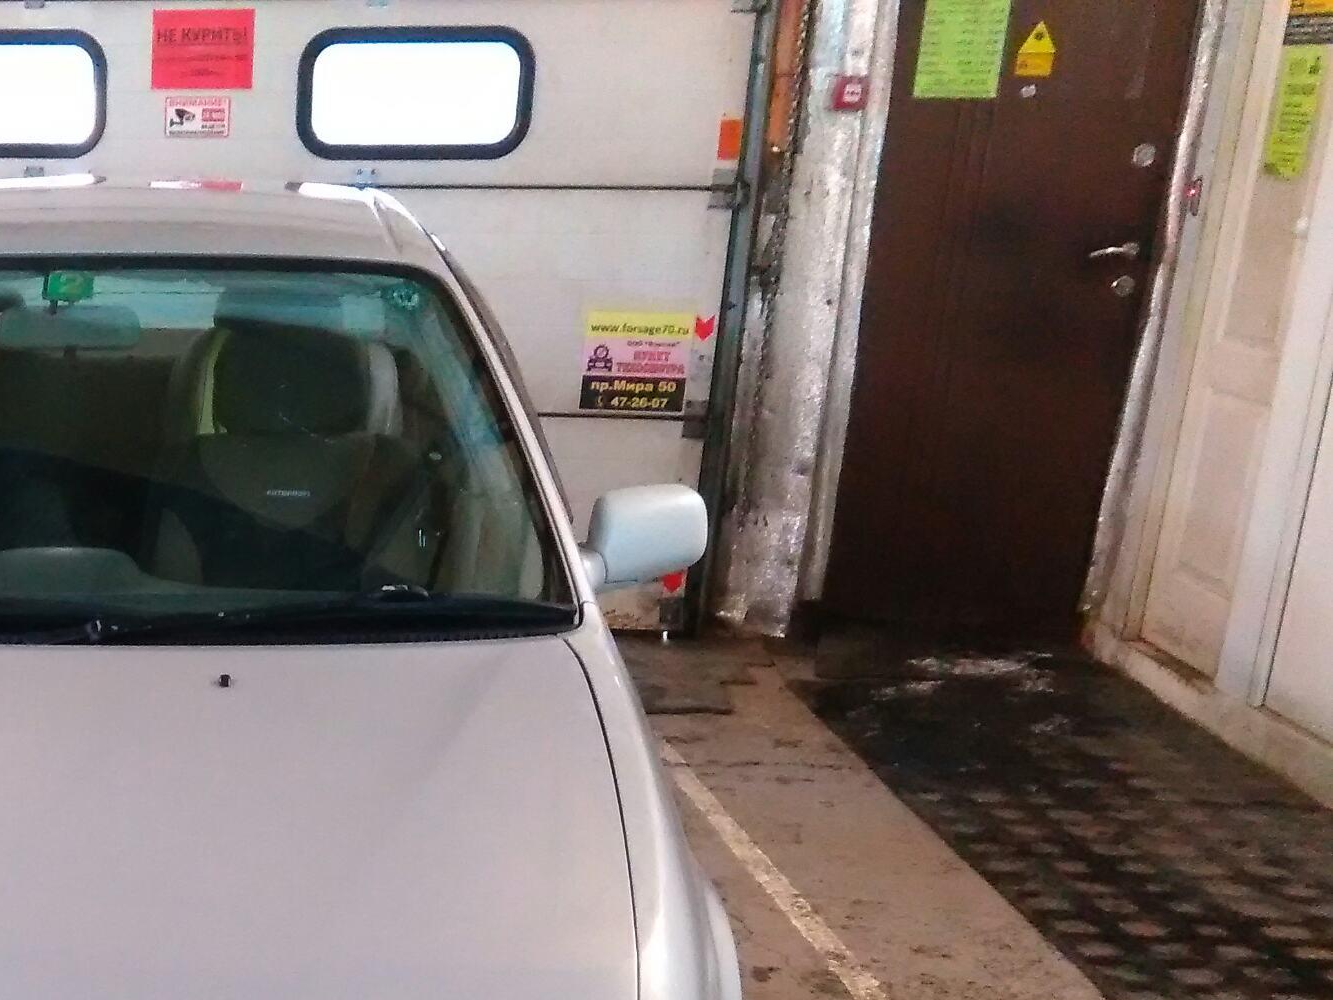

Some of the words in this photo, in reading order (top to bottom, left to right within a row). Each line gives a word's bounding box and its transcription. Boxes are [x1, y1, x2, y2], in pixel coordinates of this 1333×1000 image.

[157, 28, 177, 43] НЕ
[181, 26, 247, 45] КУРИТЬ!
[590, 322, 690, 336] www.forsage70.ru
[590, 380, 654, 393] пр.Мира
[658, 381, 677, 392] 50
[610, 396, 669, 408] 47-26-07
